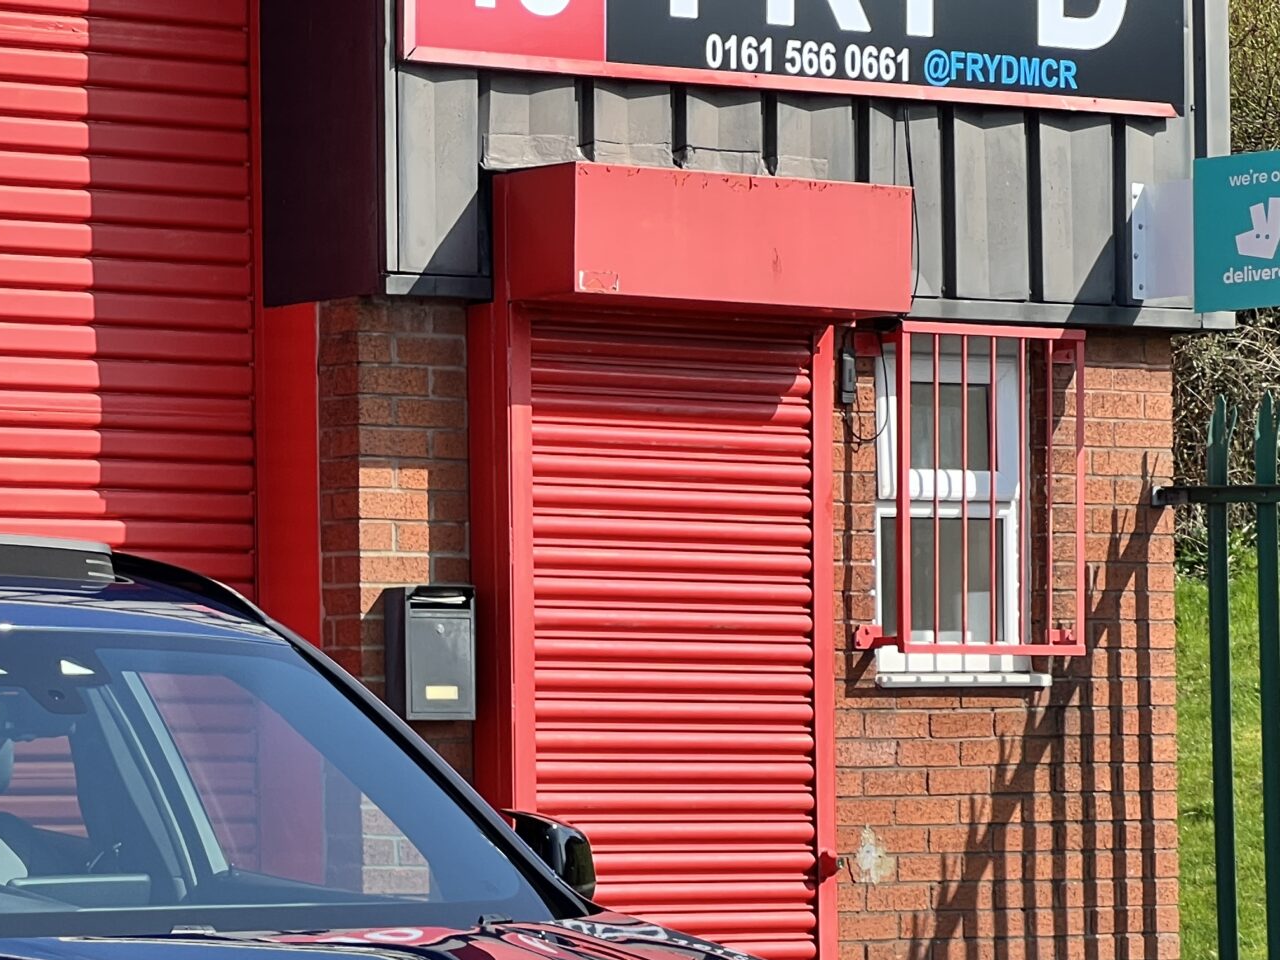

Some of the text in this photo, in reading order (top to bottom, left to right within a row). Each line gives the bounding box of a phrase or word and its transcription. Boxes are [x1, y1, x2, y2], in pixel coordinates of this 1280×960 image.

[705, 33, 1079, 90] 0161 566 0661 @FRYDMCR
[1228, 169, 1268, 187] we're
[1223, 265, 1280, 284] deliver
